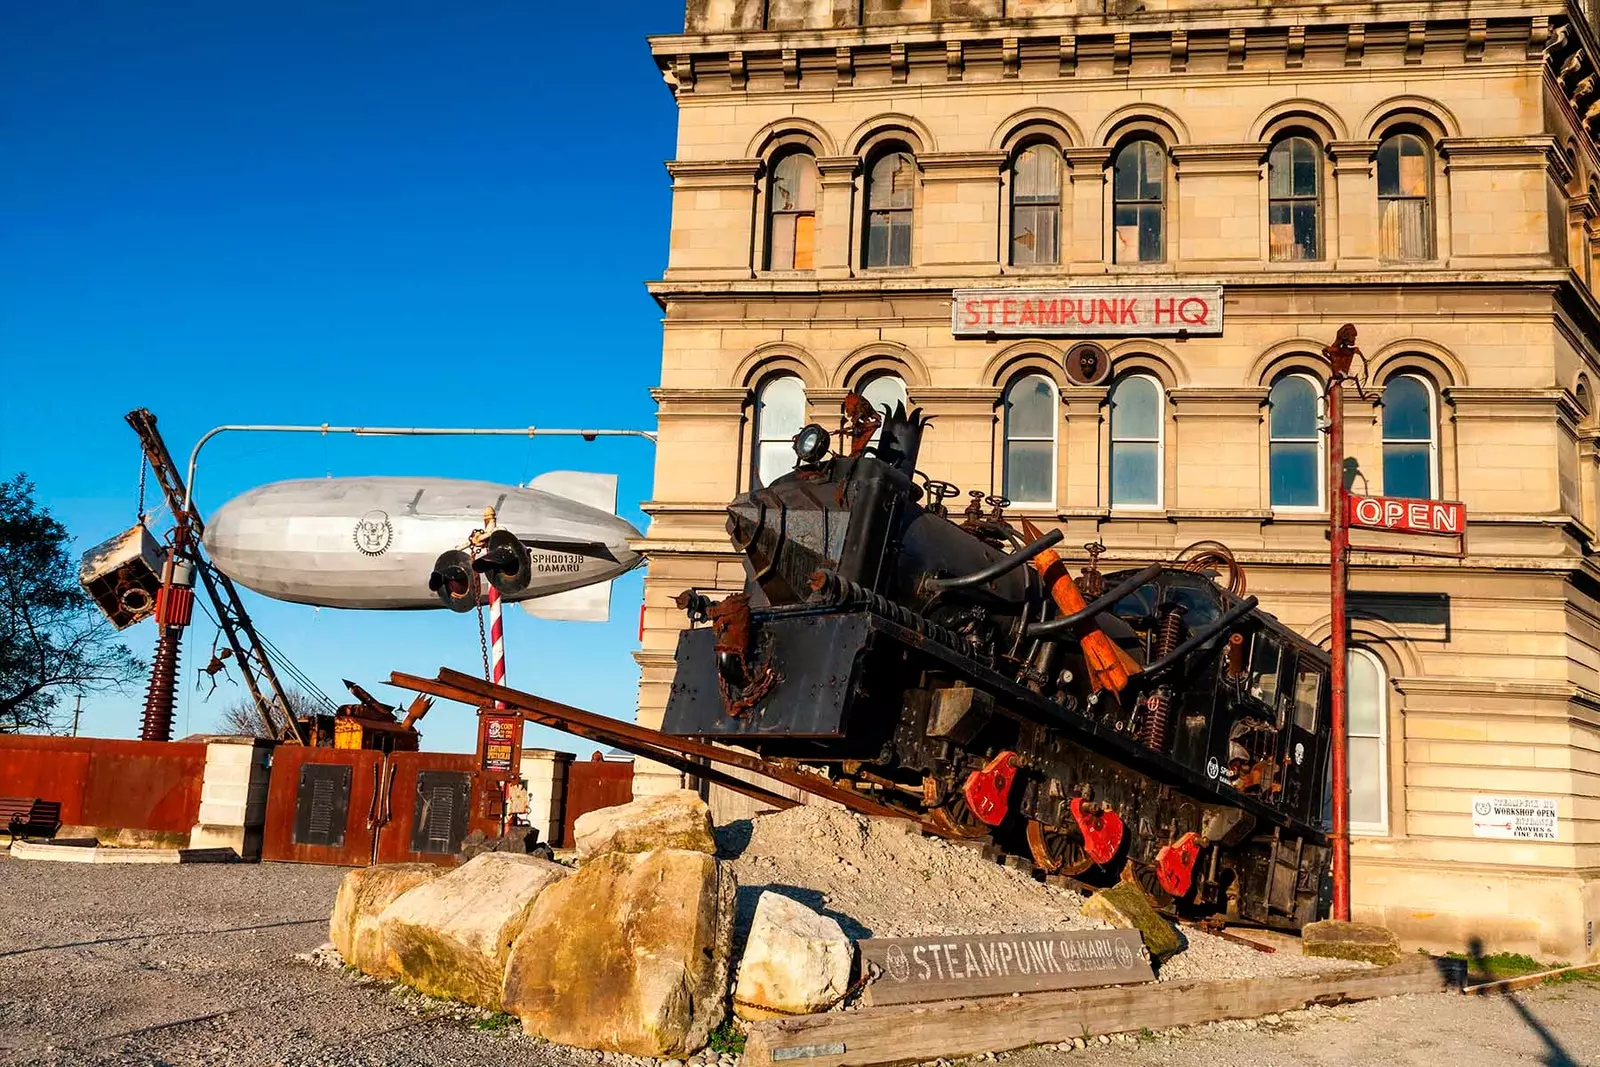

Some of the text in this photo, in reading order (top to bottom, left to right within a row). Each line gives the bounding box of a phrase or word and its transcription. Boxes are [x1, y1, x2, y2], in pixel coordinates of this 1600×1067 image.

[964, 297, 1209, 326] STEAMPUNK HQ
[1356, 498, 1457, 531] OPEN
[538, 564, 580, 572] OAMARU
[1494, 807, 1556, 817] WORKSHOP OPEN
[912, 939, 1113, 980] STEAMPUNK OAMARU
